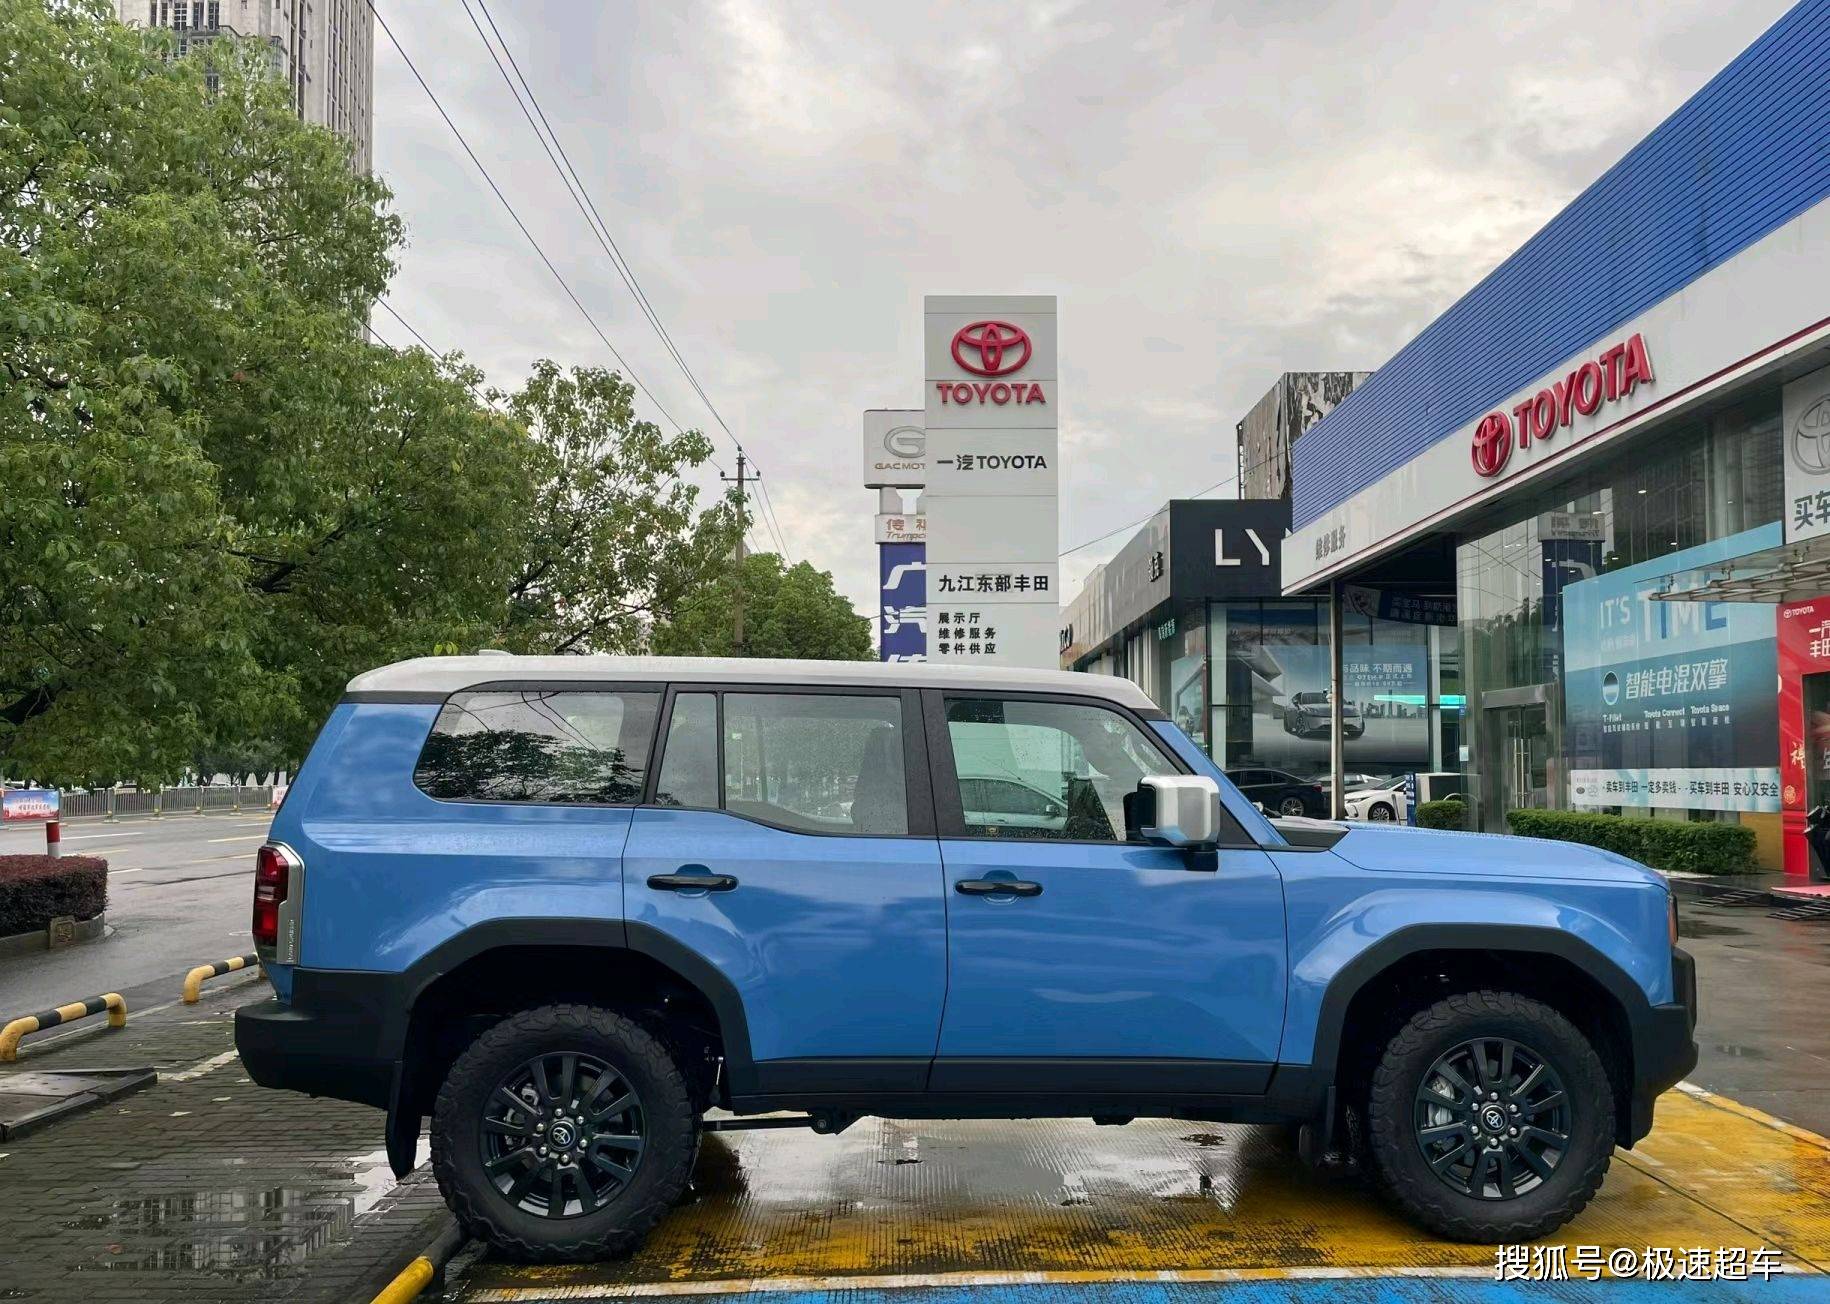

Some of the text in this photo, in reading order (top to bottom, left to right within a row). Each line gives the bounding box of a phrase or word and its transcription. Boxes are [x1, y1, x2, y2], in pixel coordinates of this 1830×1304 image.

[936, 383, 1046, 405] TOYOTA
[1513, 333, 1655, 449] TOYOTA
[1215, 528, 1292, 566] LY
[938, 574, 1049, 593] 九江东部丰田
[938, 612, 981, 625] 展示厅
[1600, 595, 1631, 630] IT'S
[1791, 606, 1815, 616] TOYOTA
[938, 627, 997, 640] 维修服务
[938, 642, 997, 655] 零件供应
[1625, 658, 1729, 700] 智能电混双擎
[1733, 782, 1779, 797] 安心又安全
